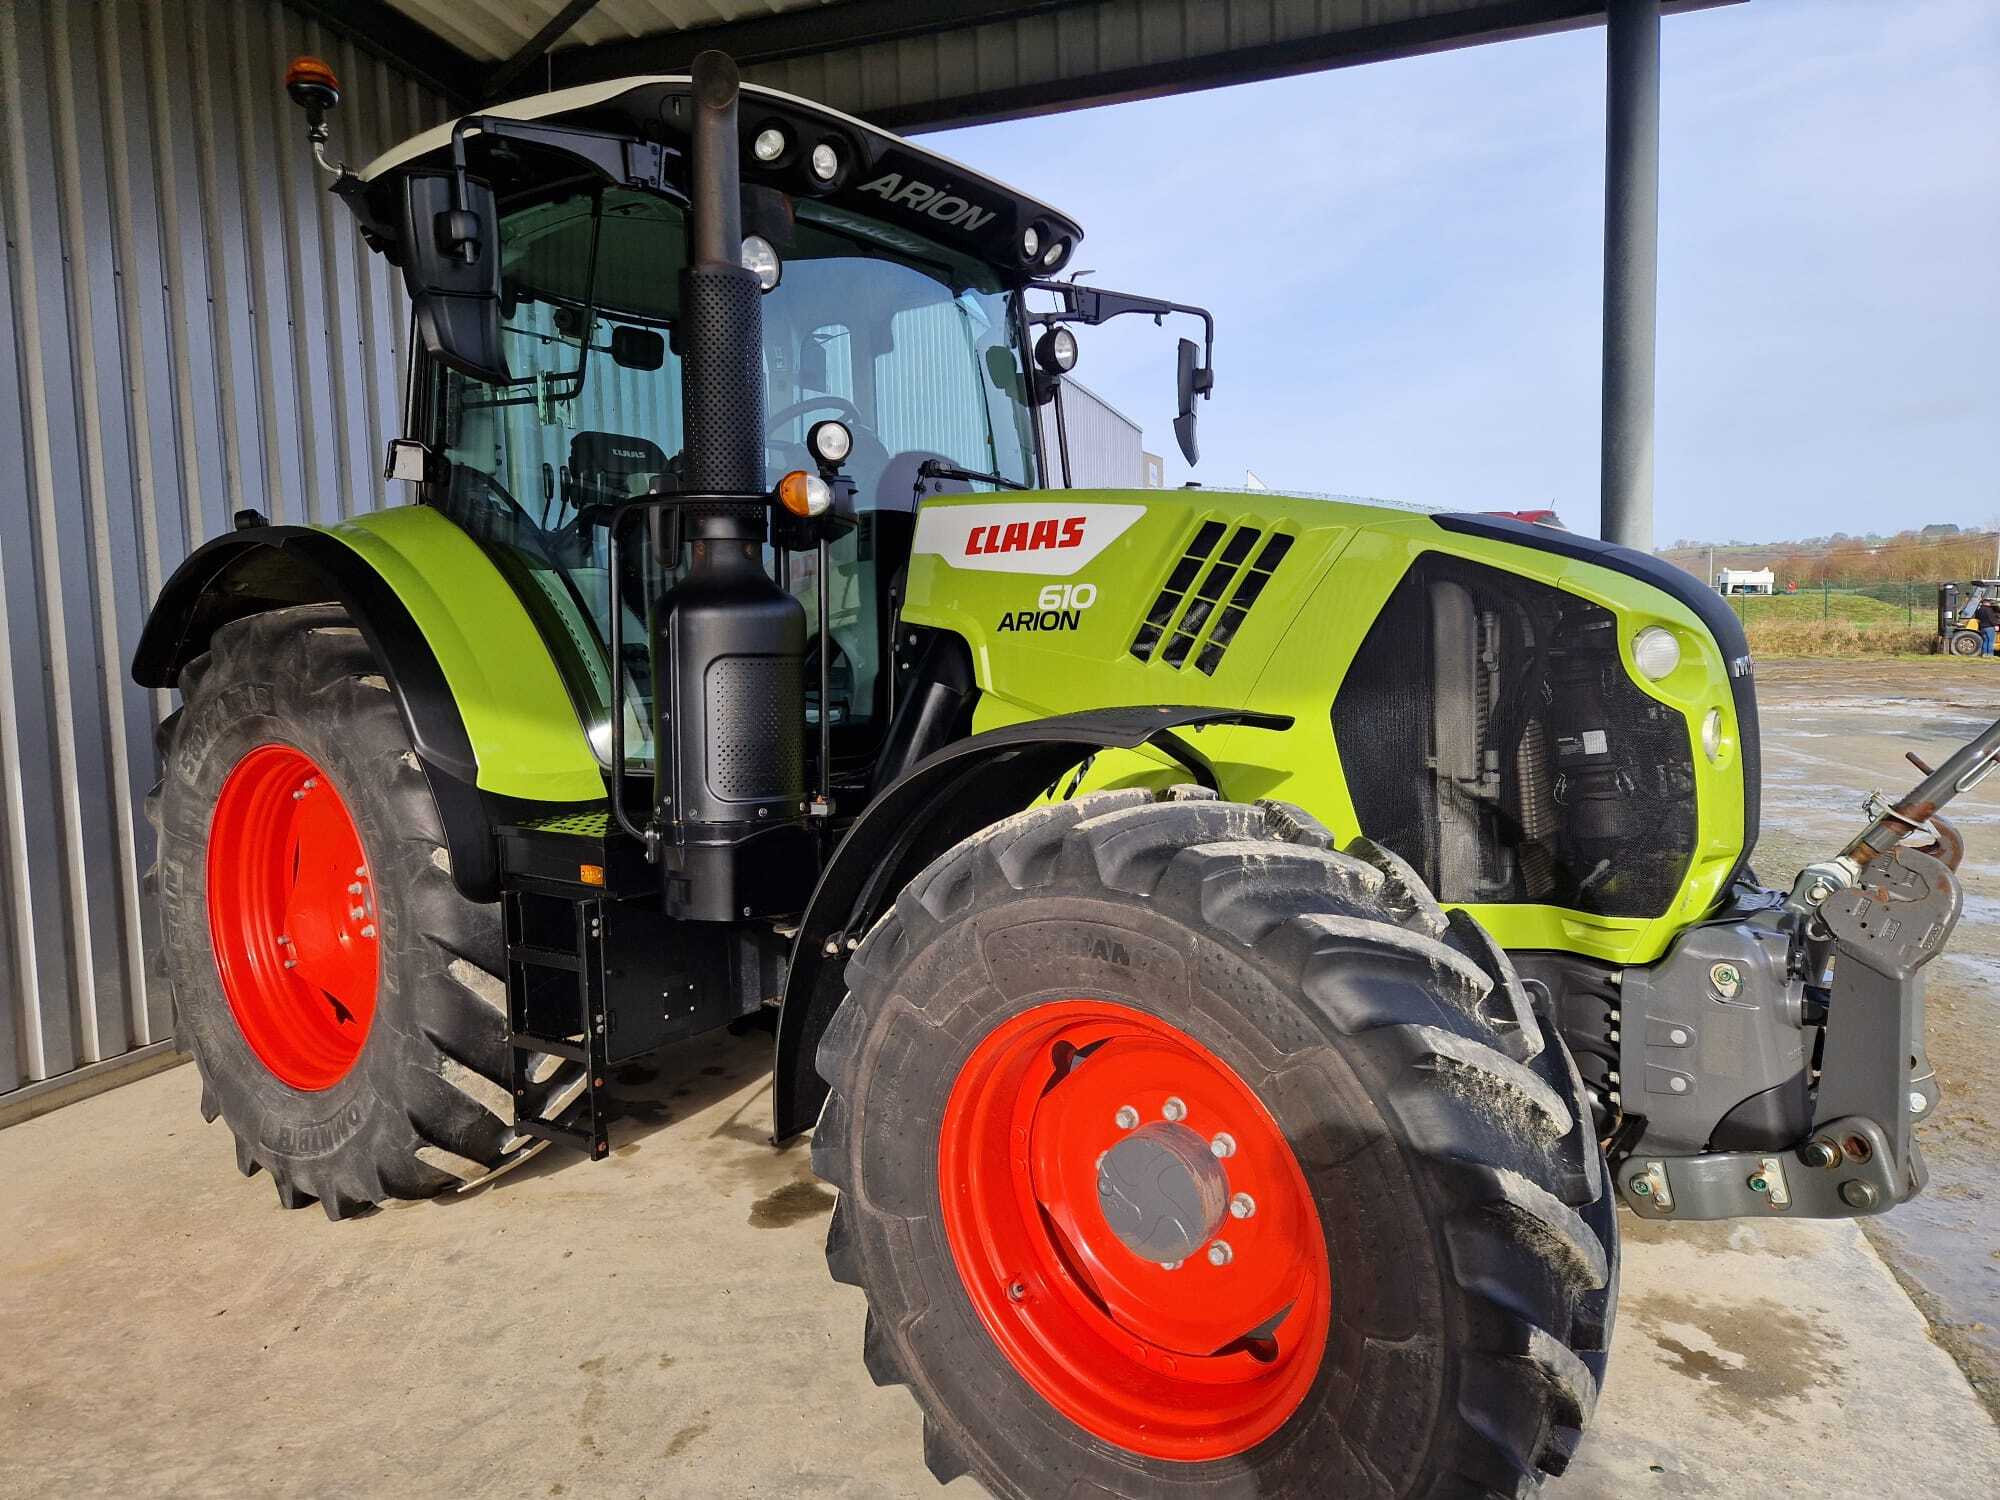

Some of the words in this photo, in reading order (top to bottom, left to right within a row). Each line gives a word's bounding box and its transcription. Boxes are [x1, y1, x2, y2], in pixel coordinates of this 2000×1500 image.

[857, 173, 996, 231] ARION
[965, 516, 1086, 555] CLAAS
[1038, 583, 1096, 610] 610
[997, 610, 1080, 632] ARION
